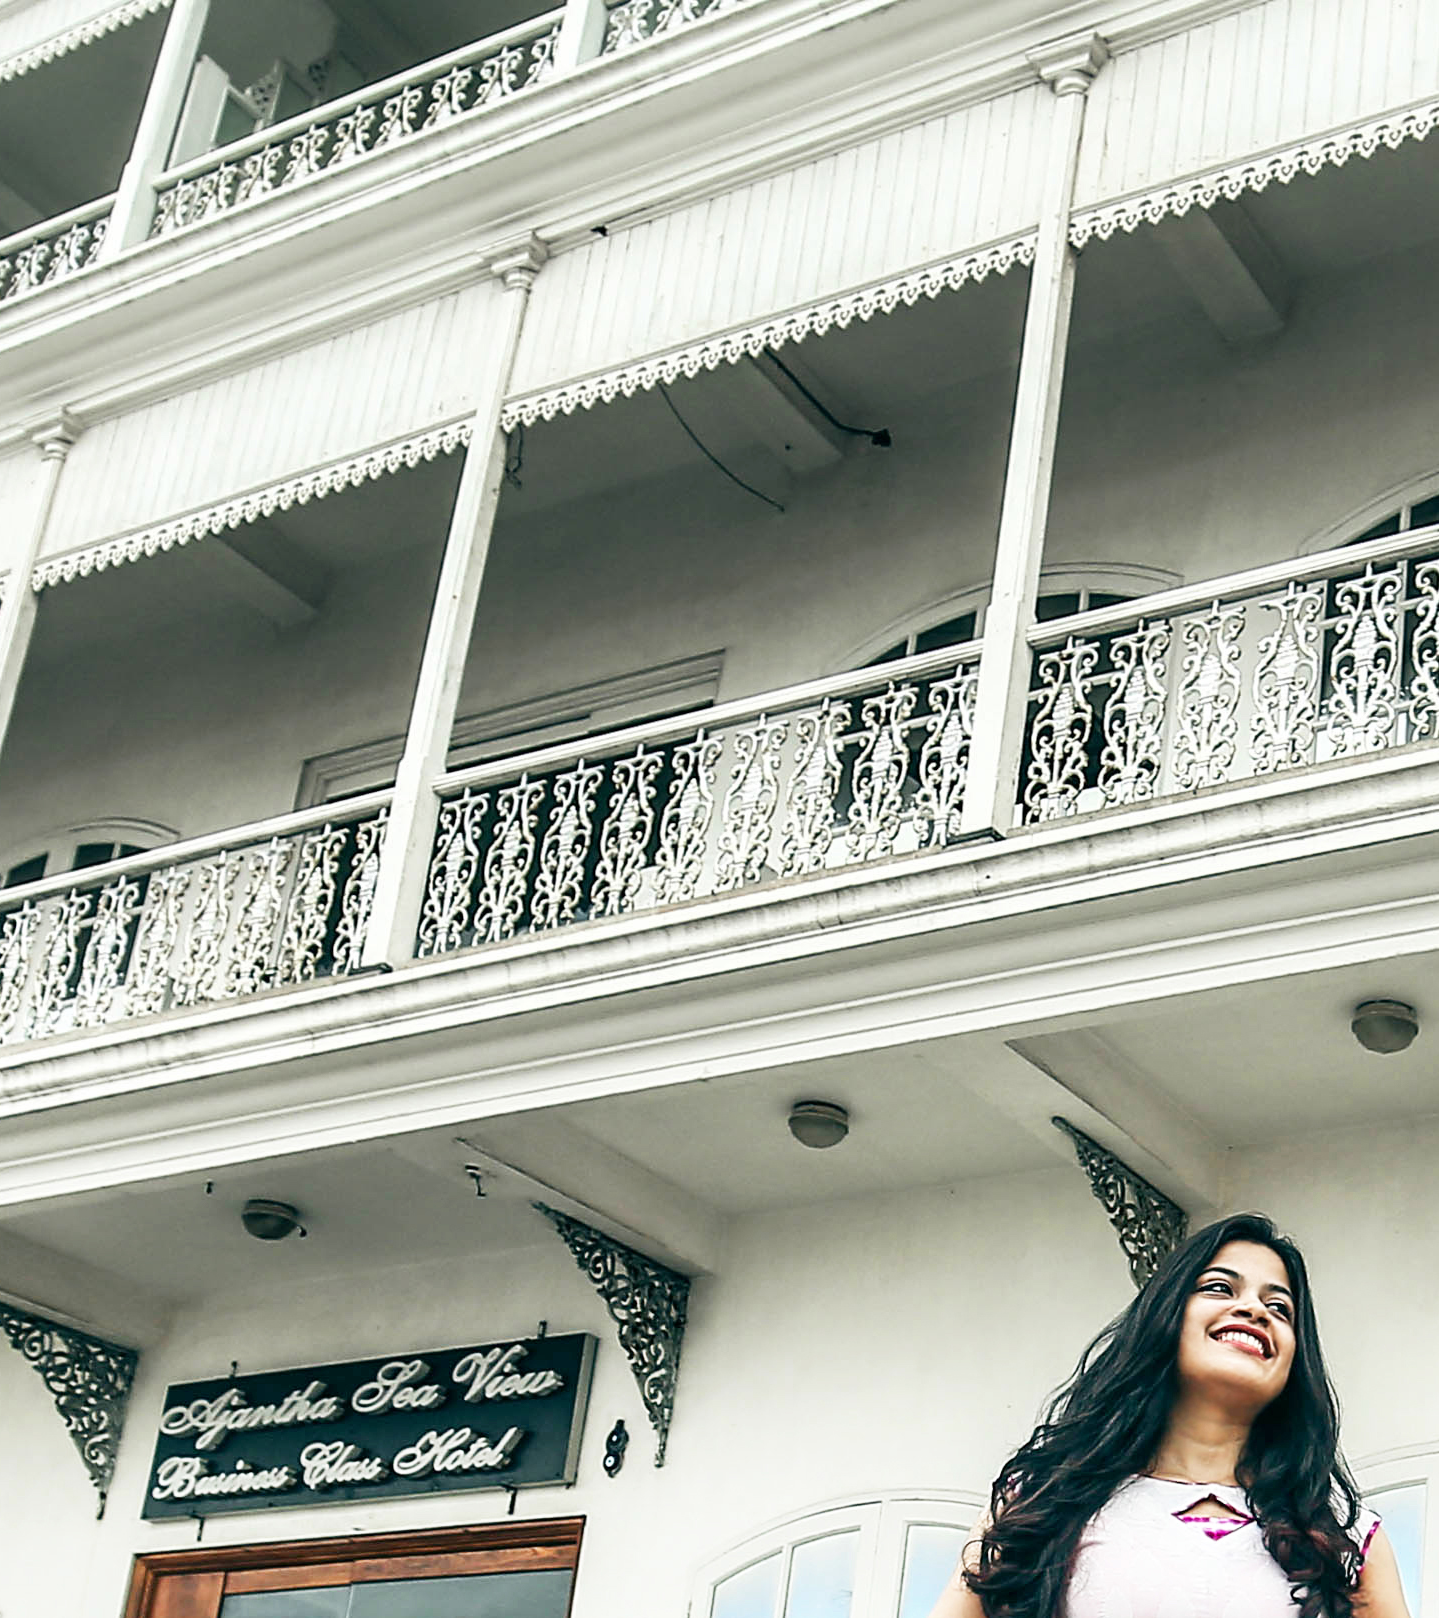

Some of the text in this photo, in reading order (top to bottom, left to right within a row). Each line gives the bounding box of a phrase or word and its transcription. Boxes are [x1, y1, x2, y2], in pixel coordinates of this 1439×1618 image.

[161, 1343, 561, 1450] Ajantha Sea View
[152, 1426, 523, 1499] Business Class Hotel
